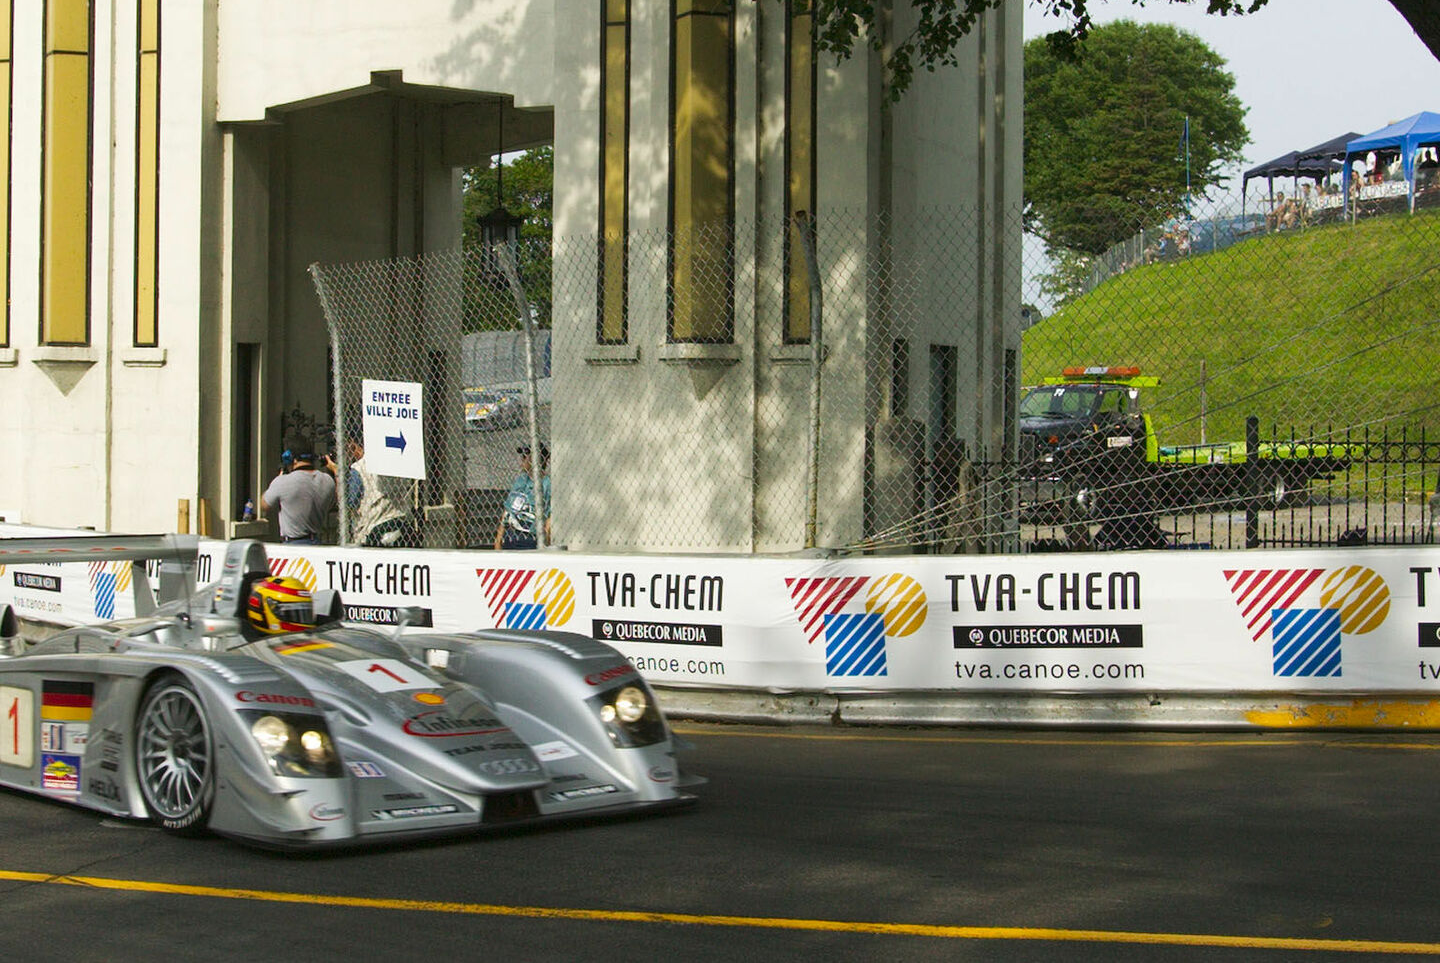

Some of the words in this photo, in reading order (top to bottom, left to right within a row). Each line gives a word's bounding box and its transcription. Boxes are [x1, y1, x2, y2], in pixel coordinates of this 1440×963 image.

[366, 405, 393, 418] VILLE
[396, 407, 419, 420] JOIE
[325, 560, 431, 597] TVA-CHEM
[587, 571, 724, 612] TVA-CHEM
[945, 571, 1141, 612] TVA-CHEM
[348, 606, 392, 623] QUEBECOR
[616, 622, 675, 642] QUEBECOR
[672, 625, 707, 642] MEDIA
[989, 628, 1069, 646] QUEBECOR
[1072, 627, 1121, 645] MEDIA
[368, 663, 409, 684] 1
[954, 660, 1145, 679] tva.canoe.com
[235, 690, 316, 708] Canon
[8, 697, 19, 756] 1
